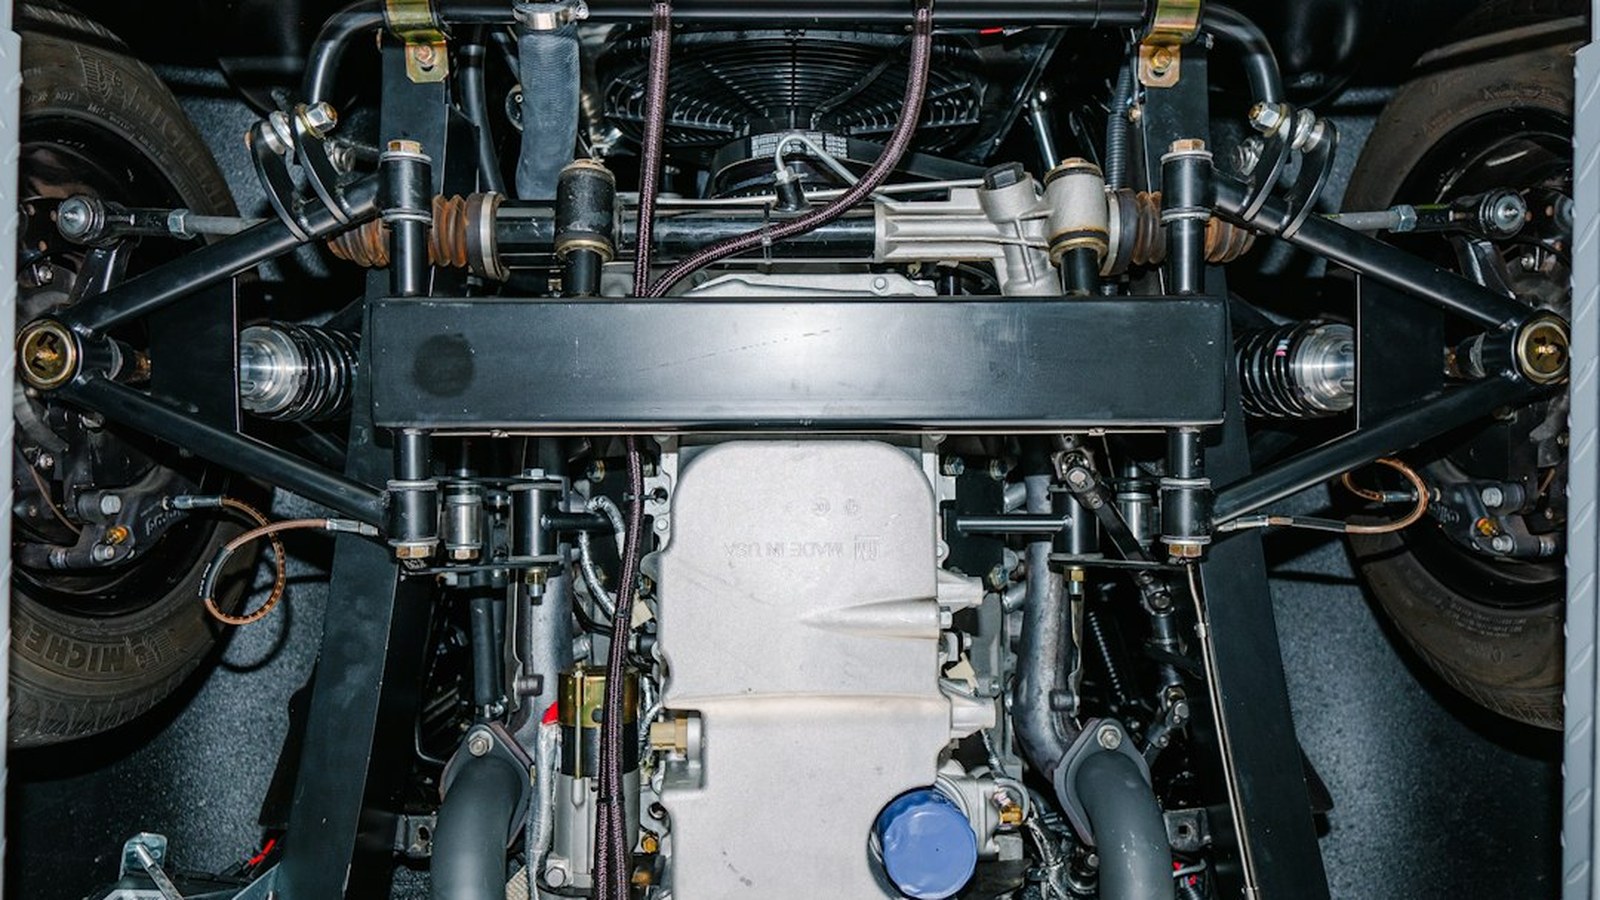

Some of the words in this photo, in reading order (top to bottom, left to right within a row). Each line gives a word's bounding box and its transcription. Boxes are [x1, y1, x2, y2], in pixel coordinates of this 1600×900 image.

[723, 541, 762, 558] USA
[766, 541, 785, 558] IN
[790, 541, 844, 558] MADE
